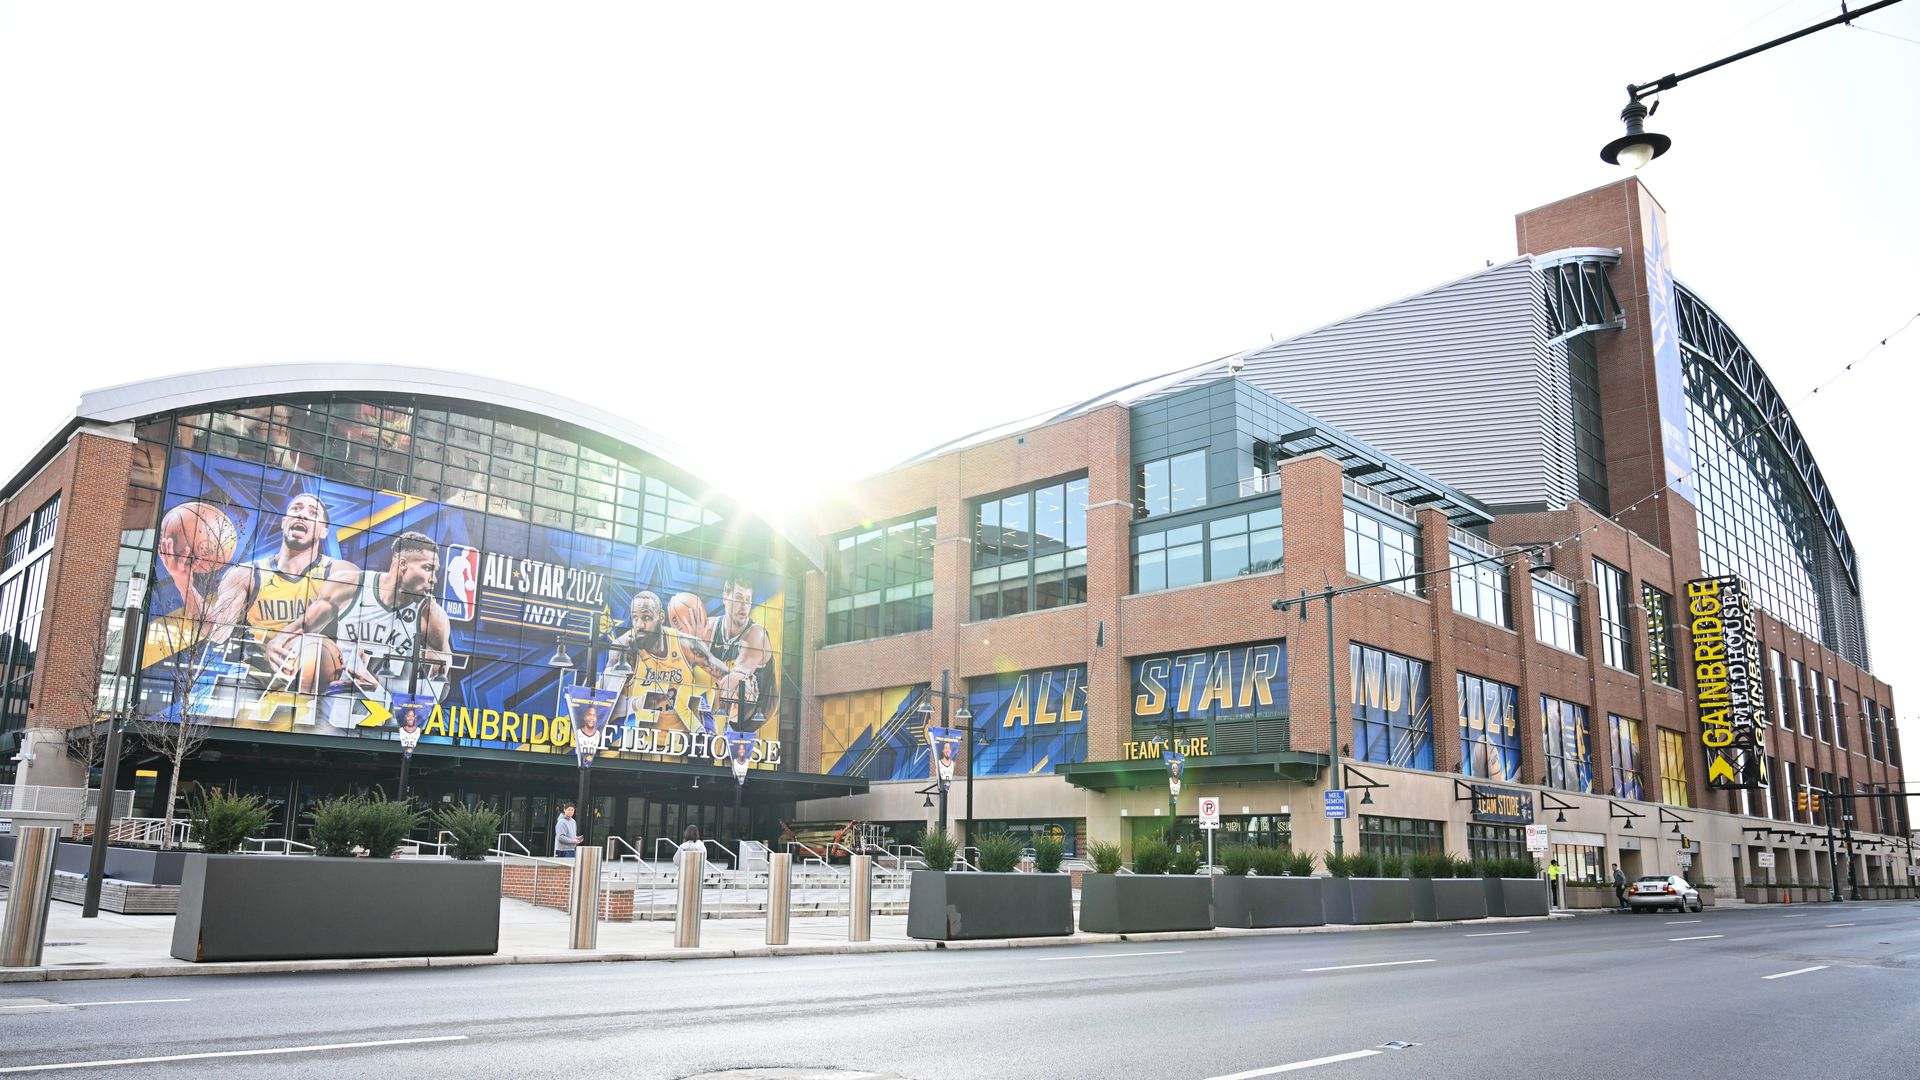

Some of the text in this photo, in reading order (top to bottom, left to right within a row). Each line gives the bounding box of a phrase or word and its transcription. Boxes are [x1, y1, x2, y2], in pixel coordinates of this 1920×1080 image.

[446, 601, 462, 616] NBA
[483, 552, 604, 606] ALL STAR 2024
[523, 604, 568, 627] INDY
[640, 667, 683, 687] LAKERS
[1135, 644, 1280, 716] STAR
[1350, 644, 1423, 716] INDY
[1688, 579, 1734, 748] GAINBRIDGE
[1722, 593, 1752, 728] FIELDHOUSE
[1739, 579, 1766, 748] GAINBRIDGE
[1003, 668, 1084, 728] ALL
[1456, 673, 1515, 737] 2024
[424, 703, 781, 764] AINBRIDG FIELDHOSE
[1123, 741, 1160, 760] TEAM
[1498, 795, 1520, 816] STORE
